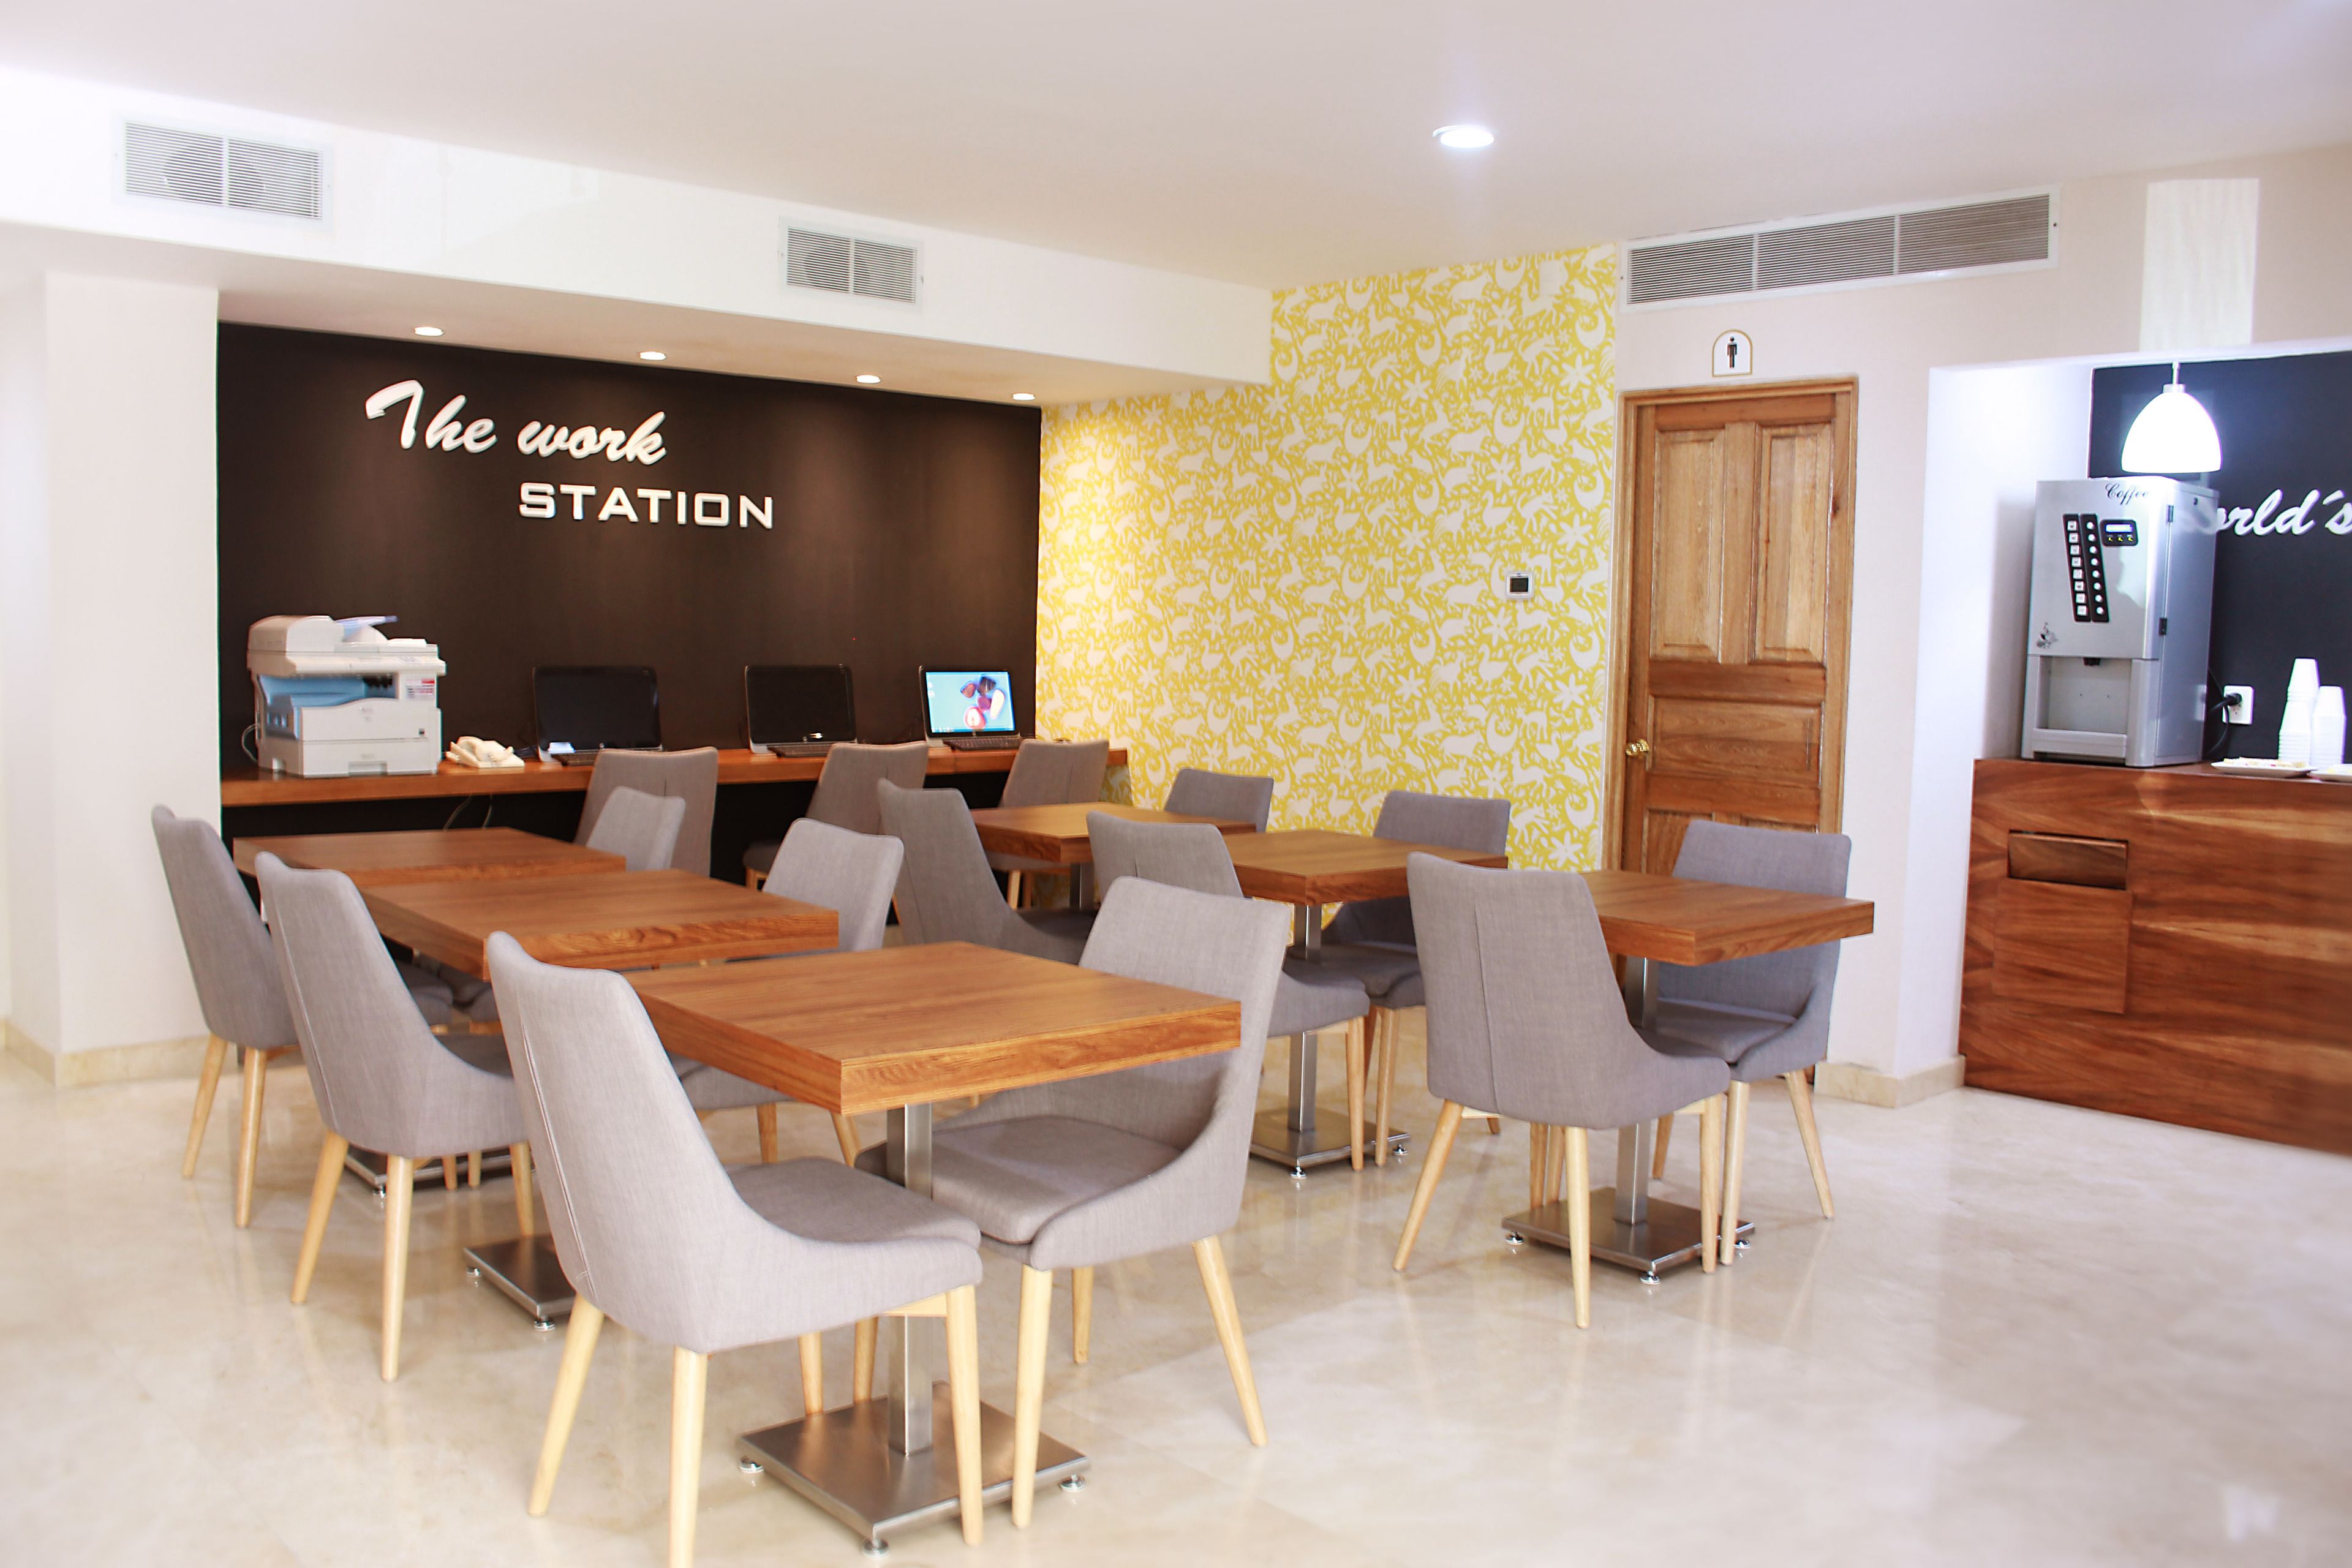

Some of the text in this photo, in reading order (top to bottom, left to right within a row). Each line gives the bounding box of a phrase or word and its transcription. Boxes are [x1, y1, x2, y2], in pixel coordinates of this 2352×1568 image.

[365, 380, 667, 466] The work
[519, 482, 774, 529] STATION
[2105, 483, 2149, 505] Coffee
